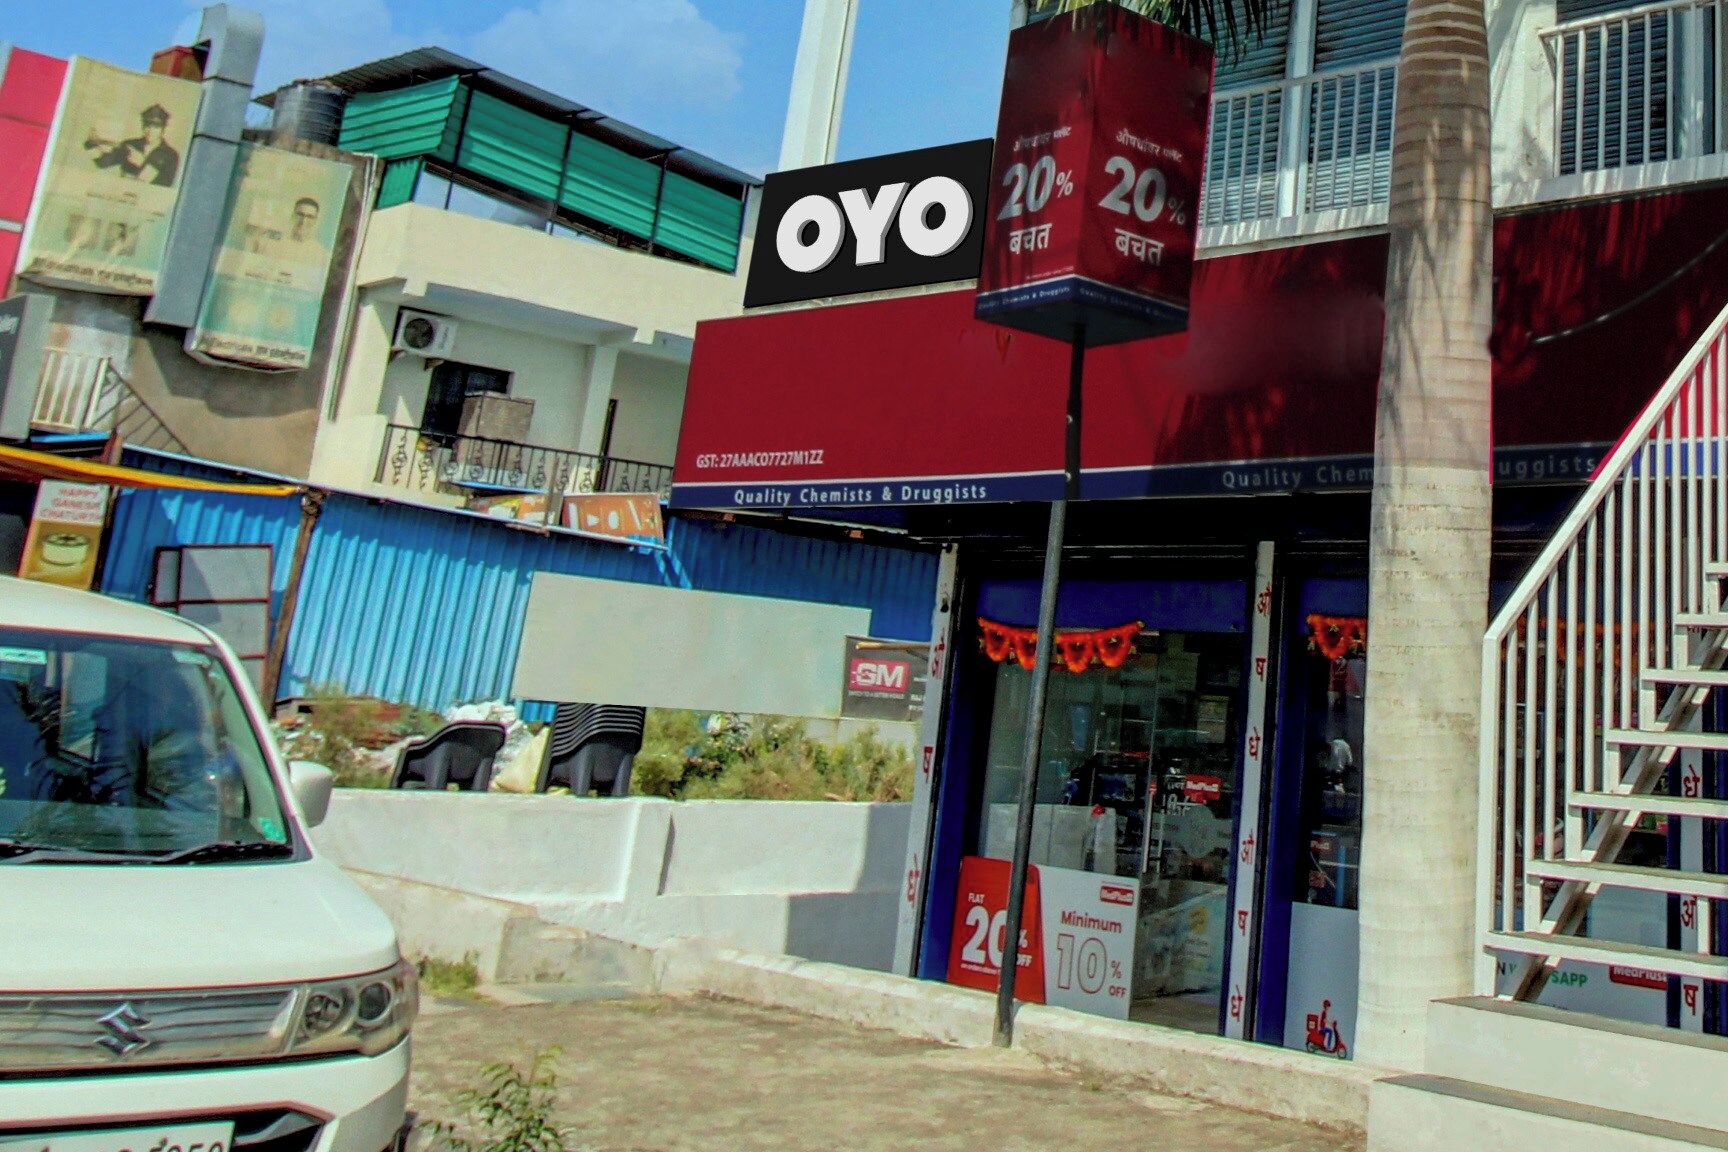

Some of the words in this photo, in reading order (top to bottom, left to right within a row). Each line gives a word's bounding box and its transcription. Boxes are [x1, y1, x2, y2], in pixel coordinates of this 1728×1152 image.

[997, 155, 1074, 221] 20%
[1099, 155, 1187, 226] 20%
[776, 175, 973, 273] OYO
[1009, 223, 1052, 255] बचत
[1114, 227, 1165, 266] बचत
[696, 454, 719, 468] GST:
[1222, 470, 1301, 490] Quality
[1316, 464, 1375, 484] Chem
[1499, 454, 1596, 481] uggists
[734, 489, 791, 507] Quality
[799, 487, 873, 504] Chemists
[882, 486, 893, 501] &
[901, 484, 987, 504] Druggists
[968, 892, 986, 904] FLAT
[1061, 909, 1123, 934] Minimum
[1109, 985, 1127, 998] OFF
